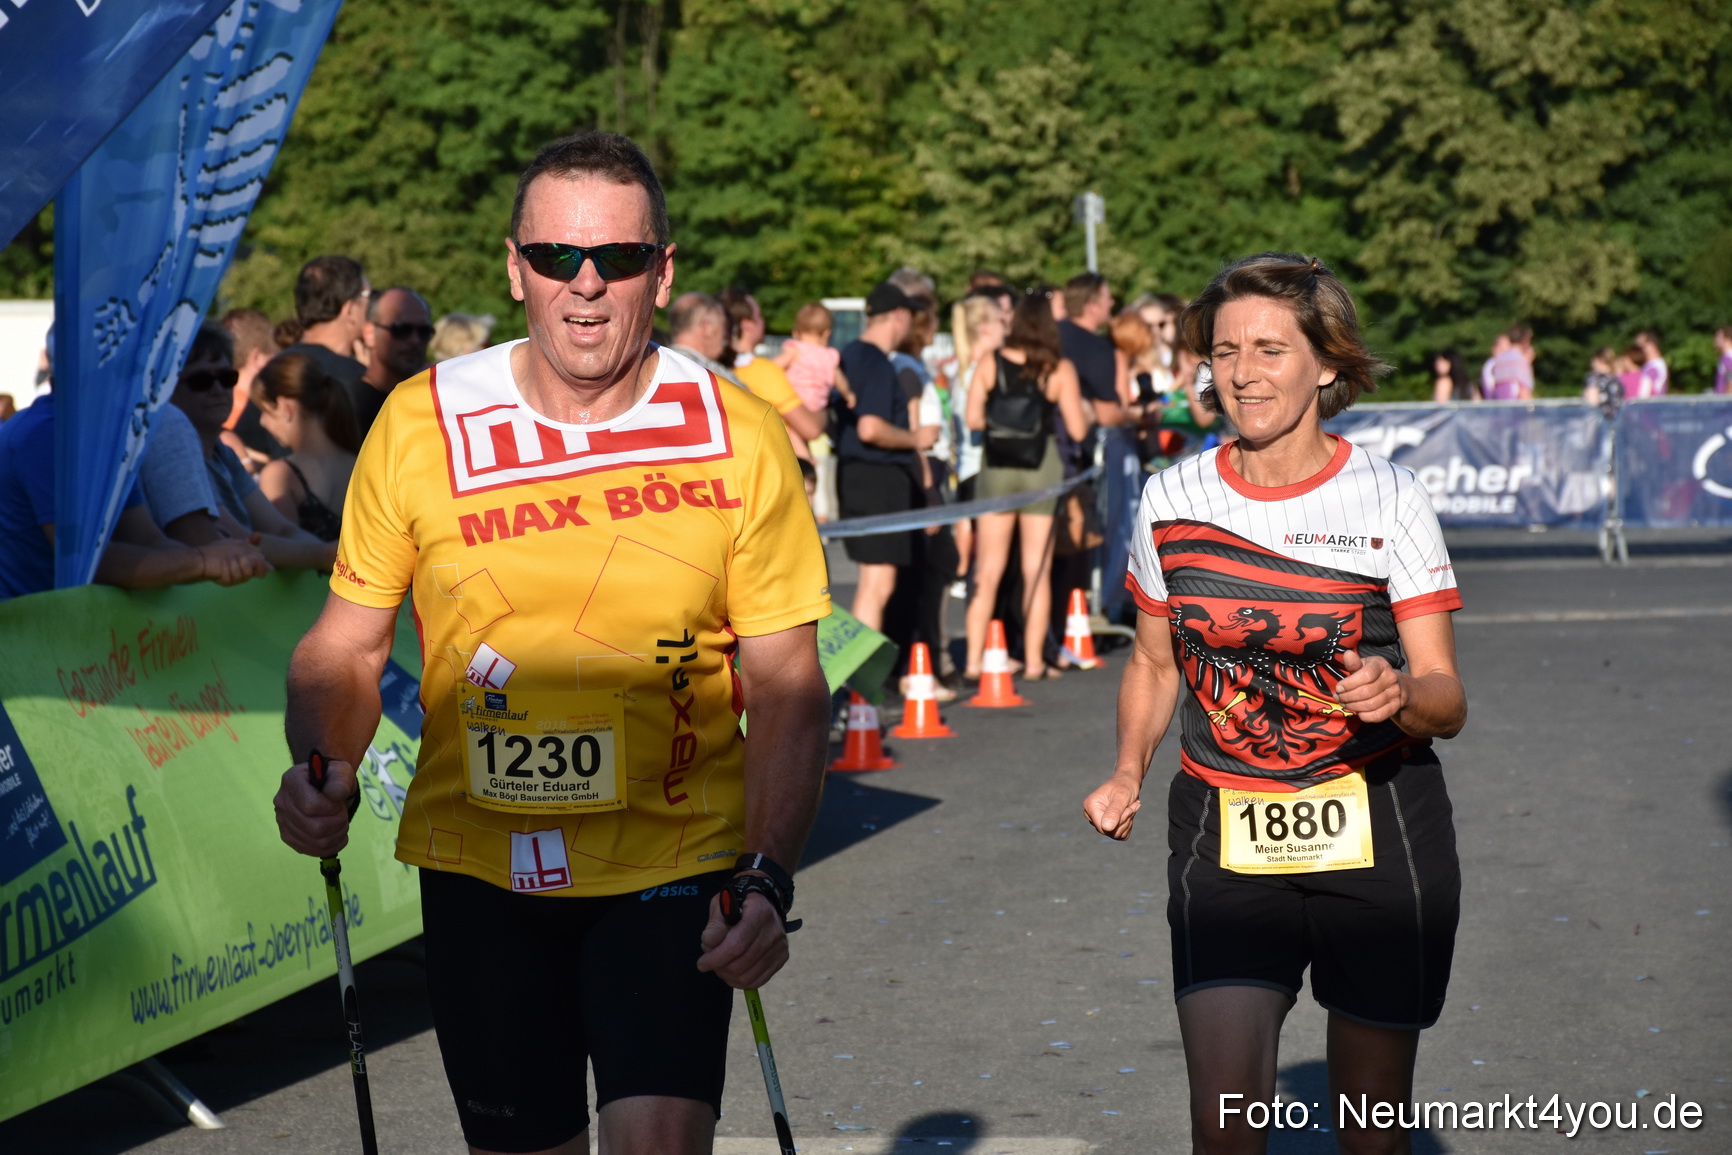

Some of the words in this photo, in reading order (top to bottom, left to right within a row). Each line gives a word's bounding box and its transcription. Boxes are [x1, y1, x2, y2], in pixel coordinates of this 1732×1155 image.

[1406, 457, 1532, 494] cher
[458, 494, 590, 547] MAX
[606, 472, 743, 521] BÖGL
[1283, 534, 1367, 547] NEUMARKT
[476, 705, 529, 720] firmenlauf
[467, 721, 506, 736] walken
[477, 733, 601, 778] 1230
[490, 778, 539, 791] Gürteler
[543, 781, 590, 791] Eduard
[483, 789, 497, 798] Max
[500, 791, 518, 802] Bögl
[521, 793, 569, 802] Bauservice
[571, 792, 599, 801] GmbH
[1228, 796, 1265, 807] walken
[1240, 799, 1347, 841] 1880
[1255, 844, 1283, 854] Meier
[1286, 843, 1335, 852] Susanne
[1287, 854, 1323, 862] Neumarkt
[659, 885, 699, 897] asics
[1, 951, 75, 1025] umarkt
[348, 1021, 367, 1074] FLASH
